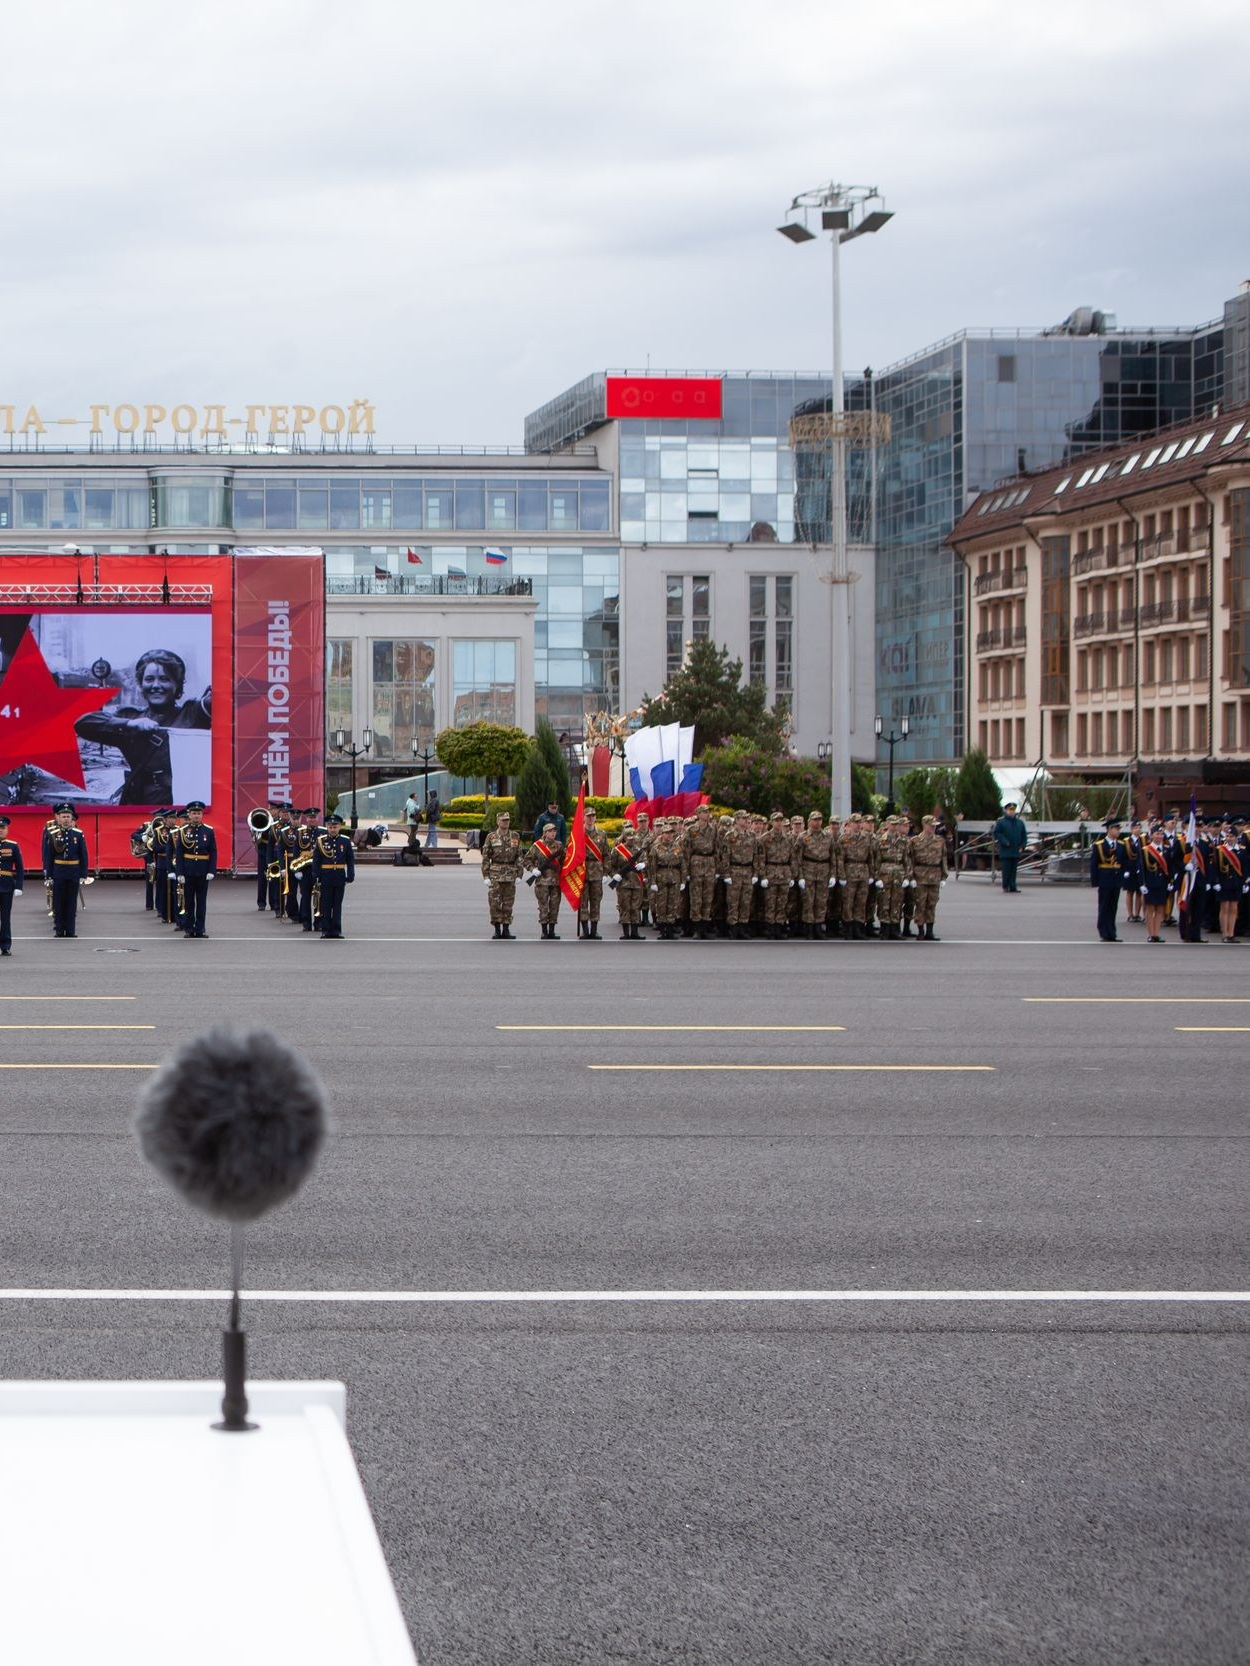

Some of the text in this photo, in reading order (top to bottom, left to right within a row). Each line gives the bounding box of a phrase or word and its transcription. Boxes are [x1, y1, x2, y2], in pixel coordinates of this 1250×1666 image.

[89, 399, 377, 439] ГОРОД-ГЕРОЙ
[262, 600, 292, 804] ДНЁМ ПОБЕДЫ!
